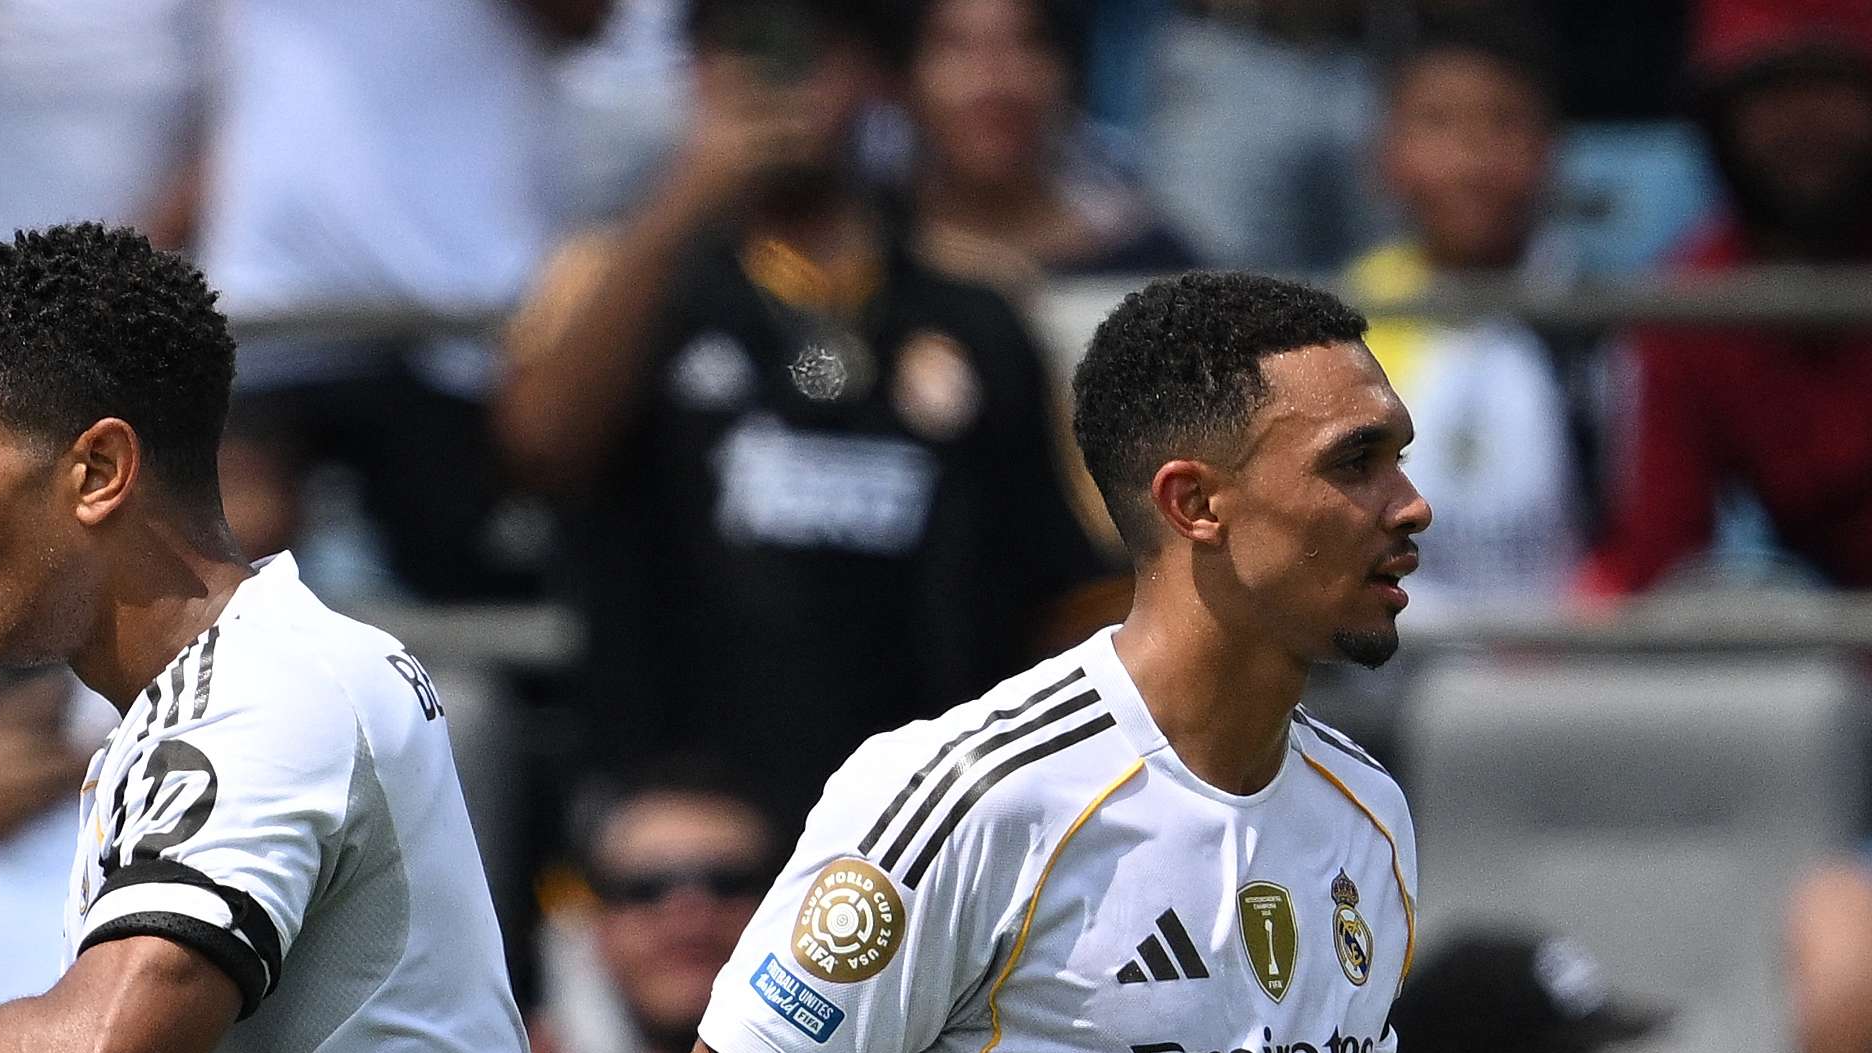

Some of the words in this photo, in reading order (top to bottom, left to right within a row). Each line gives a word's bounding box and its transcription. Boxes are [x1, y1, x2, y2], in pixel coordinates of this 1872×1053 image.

[823, 871, 874, 892] WORLD
[801, 886, 824, 926] CLUB
[873, 892, 893, 923] CUP
[876, 928, 892, 947] 25
[796, 932, 836, 974] FIFA
[847, 948, 880, 969] USA
[798, 988, 834, 1020] UNITES
[797, 1011, 820, 1031] FIFA
